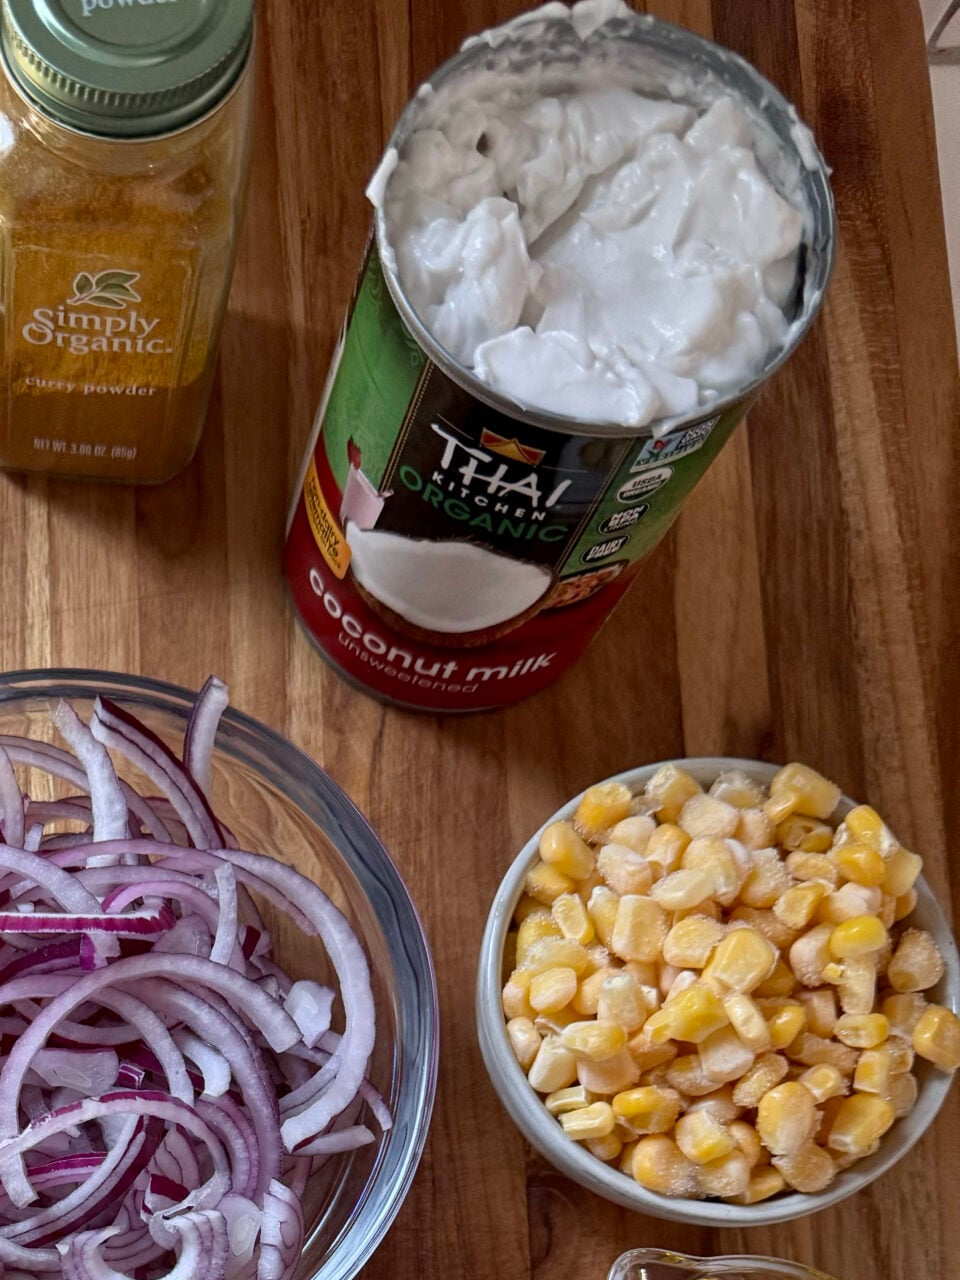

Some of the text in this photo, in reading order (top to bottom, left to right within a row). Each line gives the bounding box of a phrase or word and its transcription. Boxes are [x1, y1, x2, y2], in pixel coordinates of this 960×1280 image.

[32, 305, 161, 338] Simply
[24, 376, 157, 396] curry powder
[431, 422, 573, 508] THAI
[399, 464, 569, 542] ORGANIC
[432, 471, 547, 521] KITCHEN
[309, 568, 558, 682] coconut milk
[338, 632, 479, 693] unsweetened
